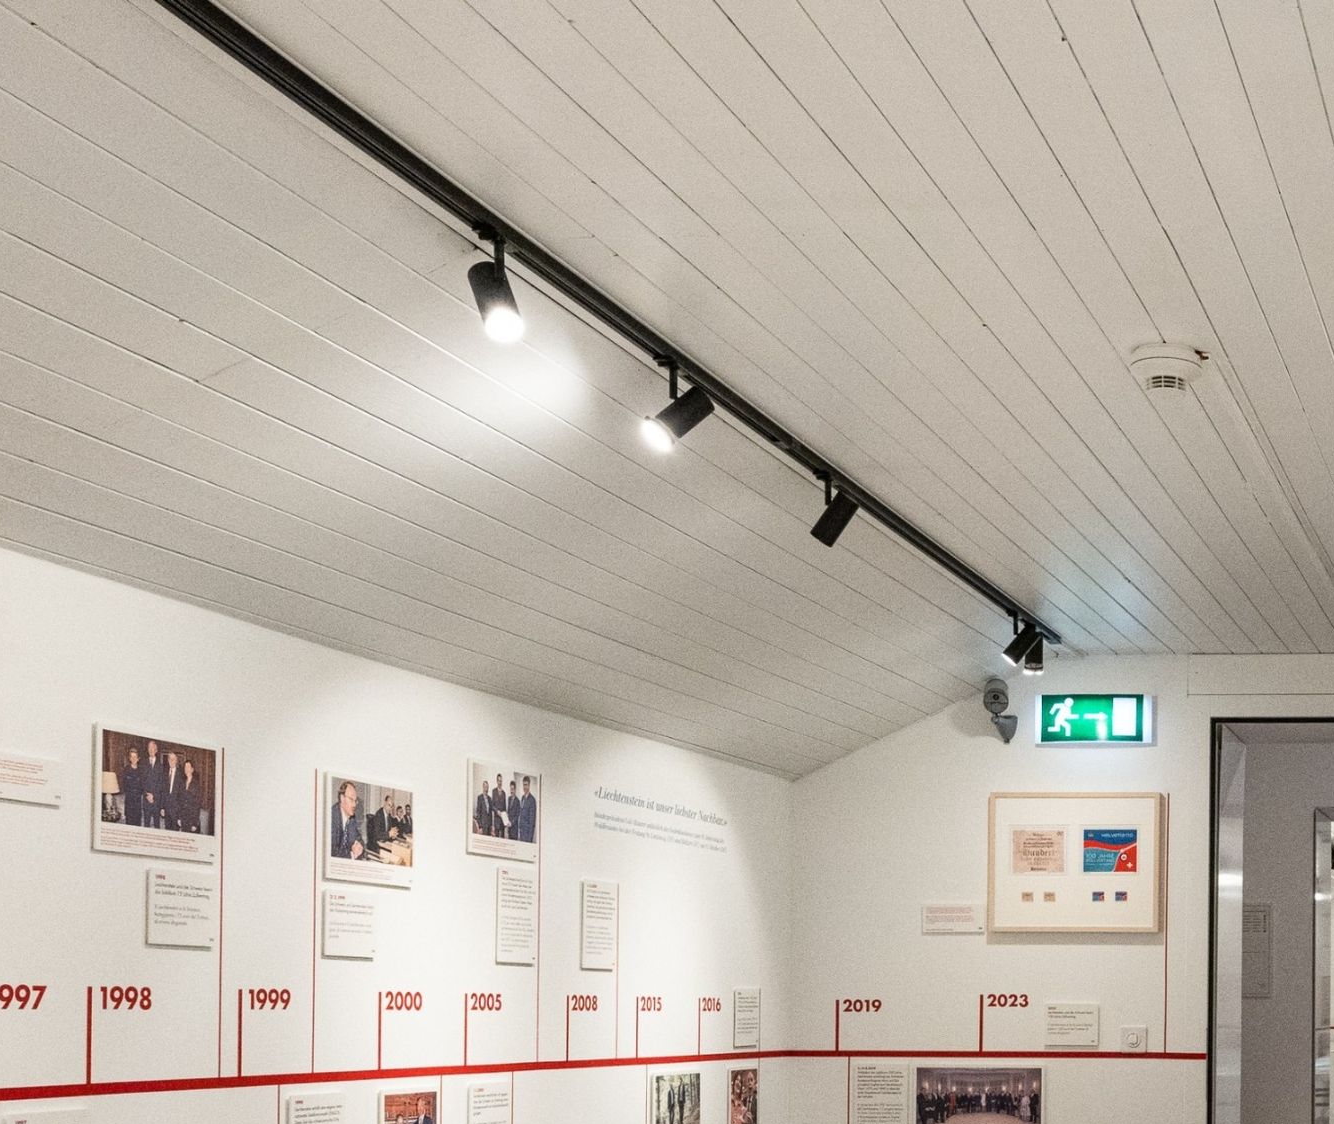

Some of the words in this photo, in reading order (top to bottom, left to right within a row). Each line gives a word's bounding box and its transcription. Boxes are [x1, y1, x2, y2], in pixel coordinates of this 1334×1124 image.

[100, 985, 152, 1011] 1998
[248, 988, 292, 1011] 1999
[385, 991, 423, 1012] 2000
[470, 992, 502, 1012] 2005
[570, 994, 598, 1013] 2008
[640, 996, 662, 1012] 2015
[701, 996, 722, 1013] 2016
[842, 998, 883, 1014] 2019
[986, 993, 1030, 1009] 2023
